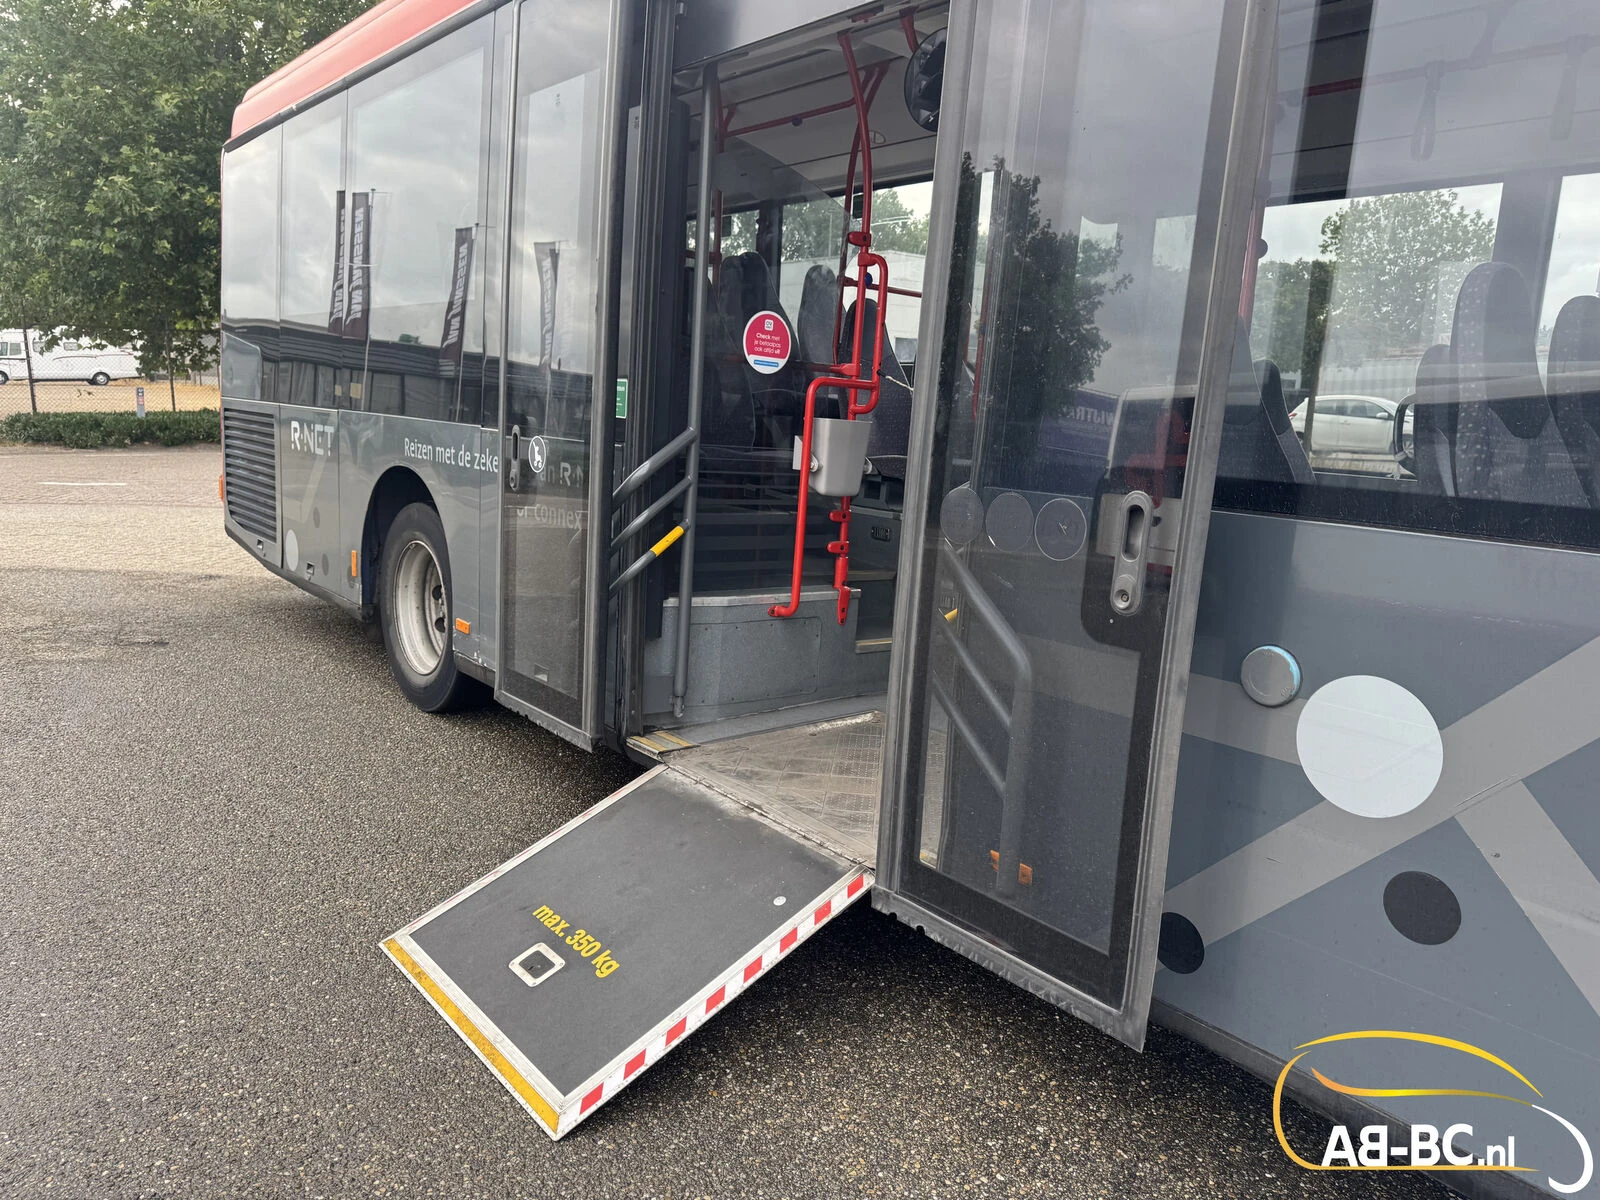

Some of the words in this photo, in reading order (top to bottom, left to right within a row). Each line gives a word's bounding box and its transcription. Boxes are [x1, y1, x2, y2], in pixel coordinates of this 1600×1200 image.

[404, 437, 433, 461] Reizen
[435, 444, 455, 465] met
[457, 444, 471, 468] de
[474, 447, 499, 473] zeke
[532, 905, 570, 937] max.
[565, 929, 601, 957] 350
[591, 949, 620, 978] kg
